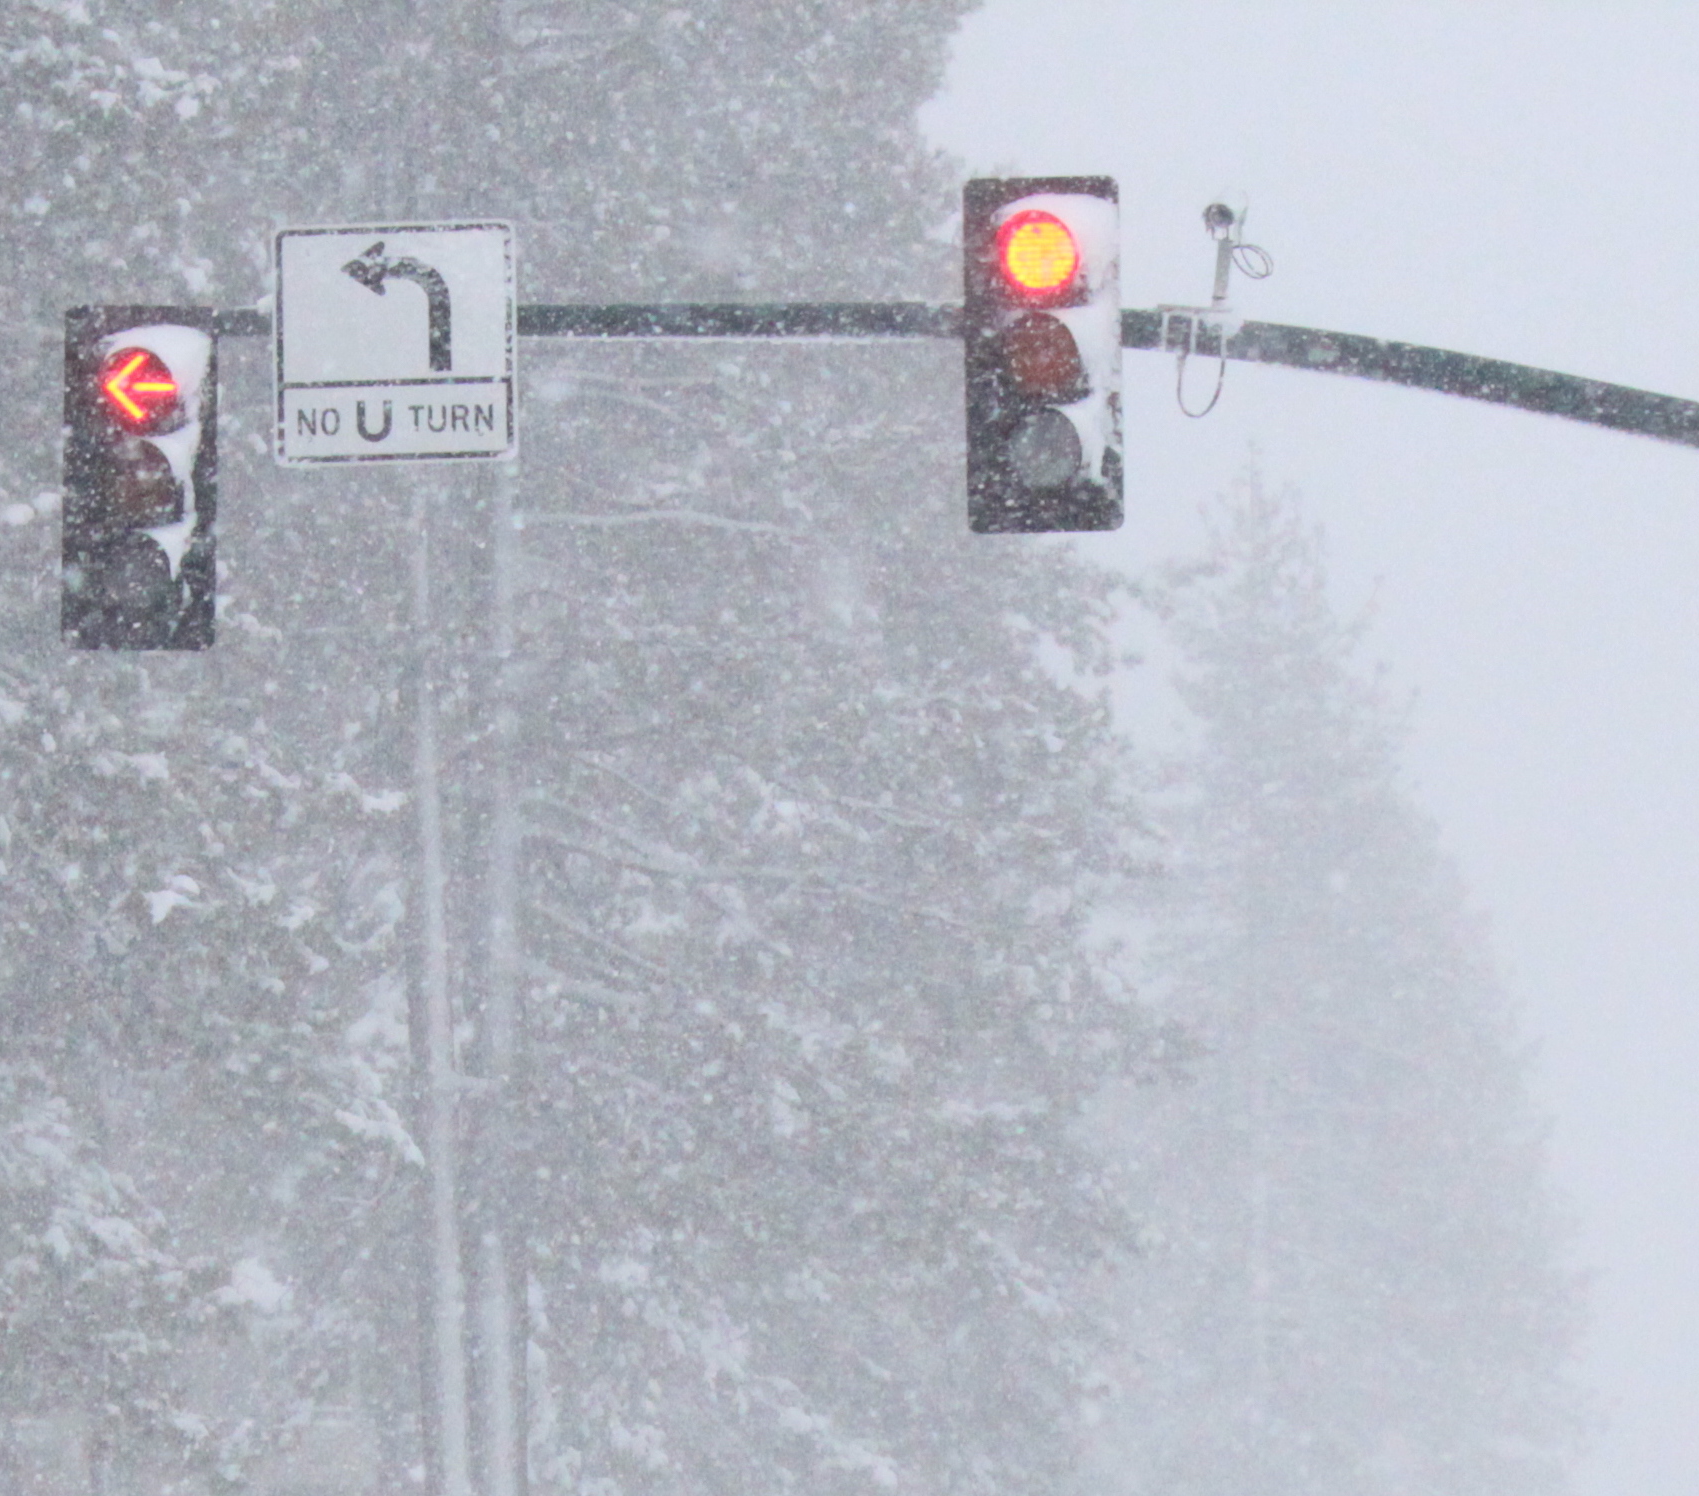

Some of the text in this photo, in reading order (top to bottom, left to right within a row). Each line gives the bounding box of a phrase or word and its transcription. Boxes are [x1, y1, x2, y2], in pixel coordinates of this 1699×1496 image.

[296, 400, 494, 443] NO U TURN
